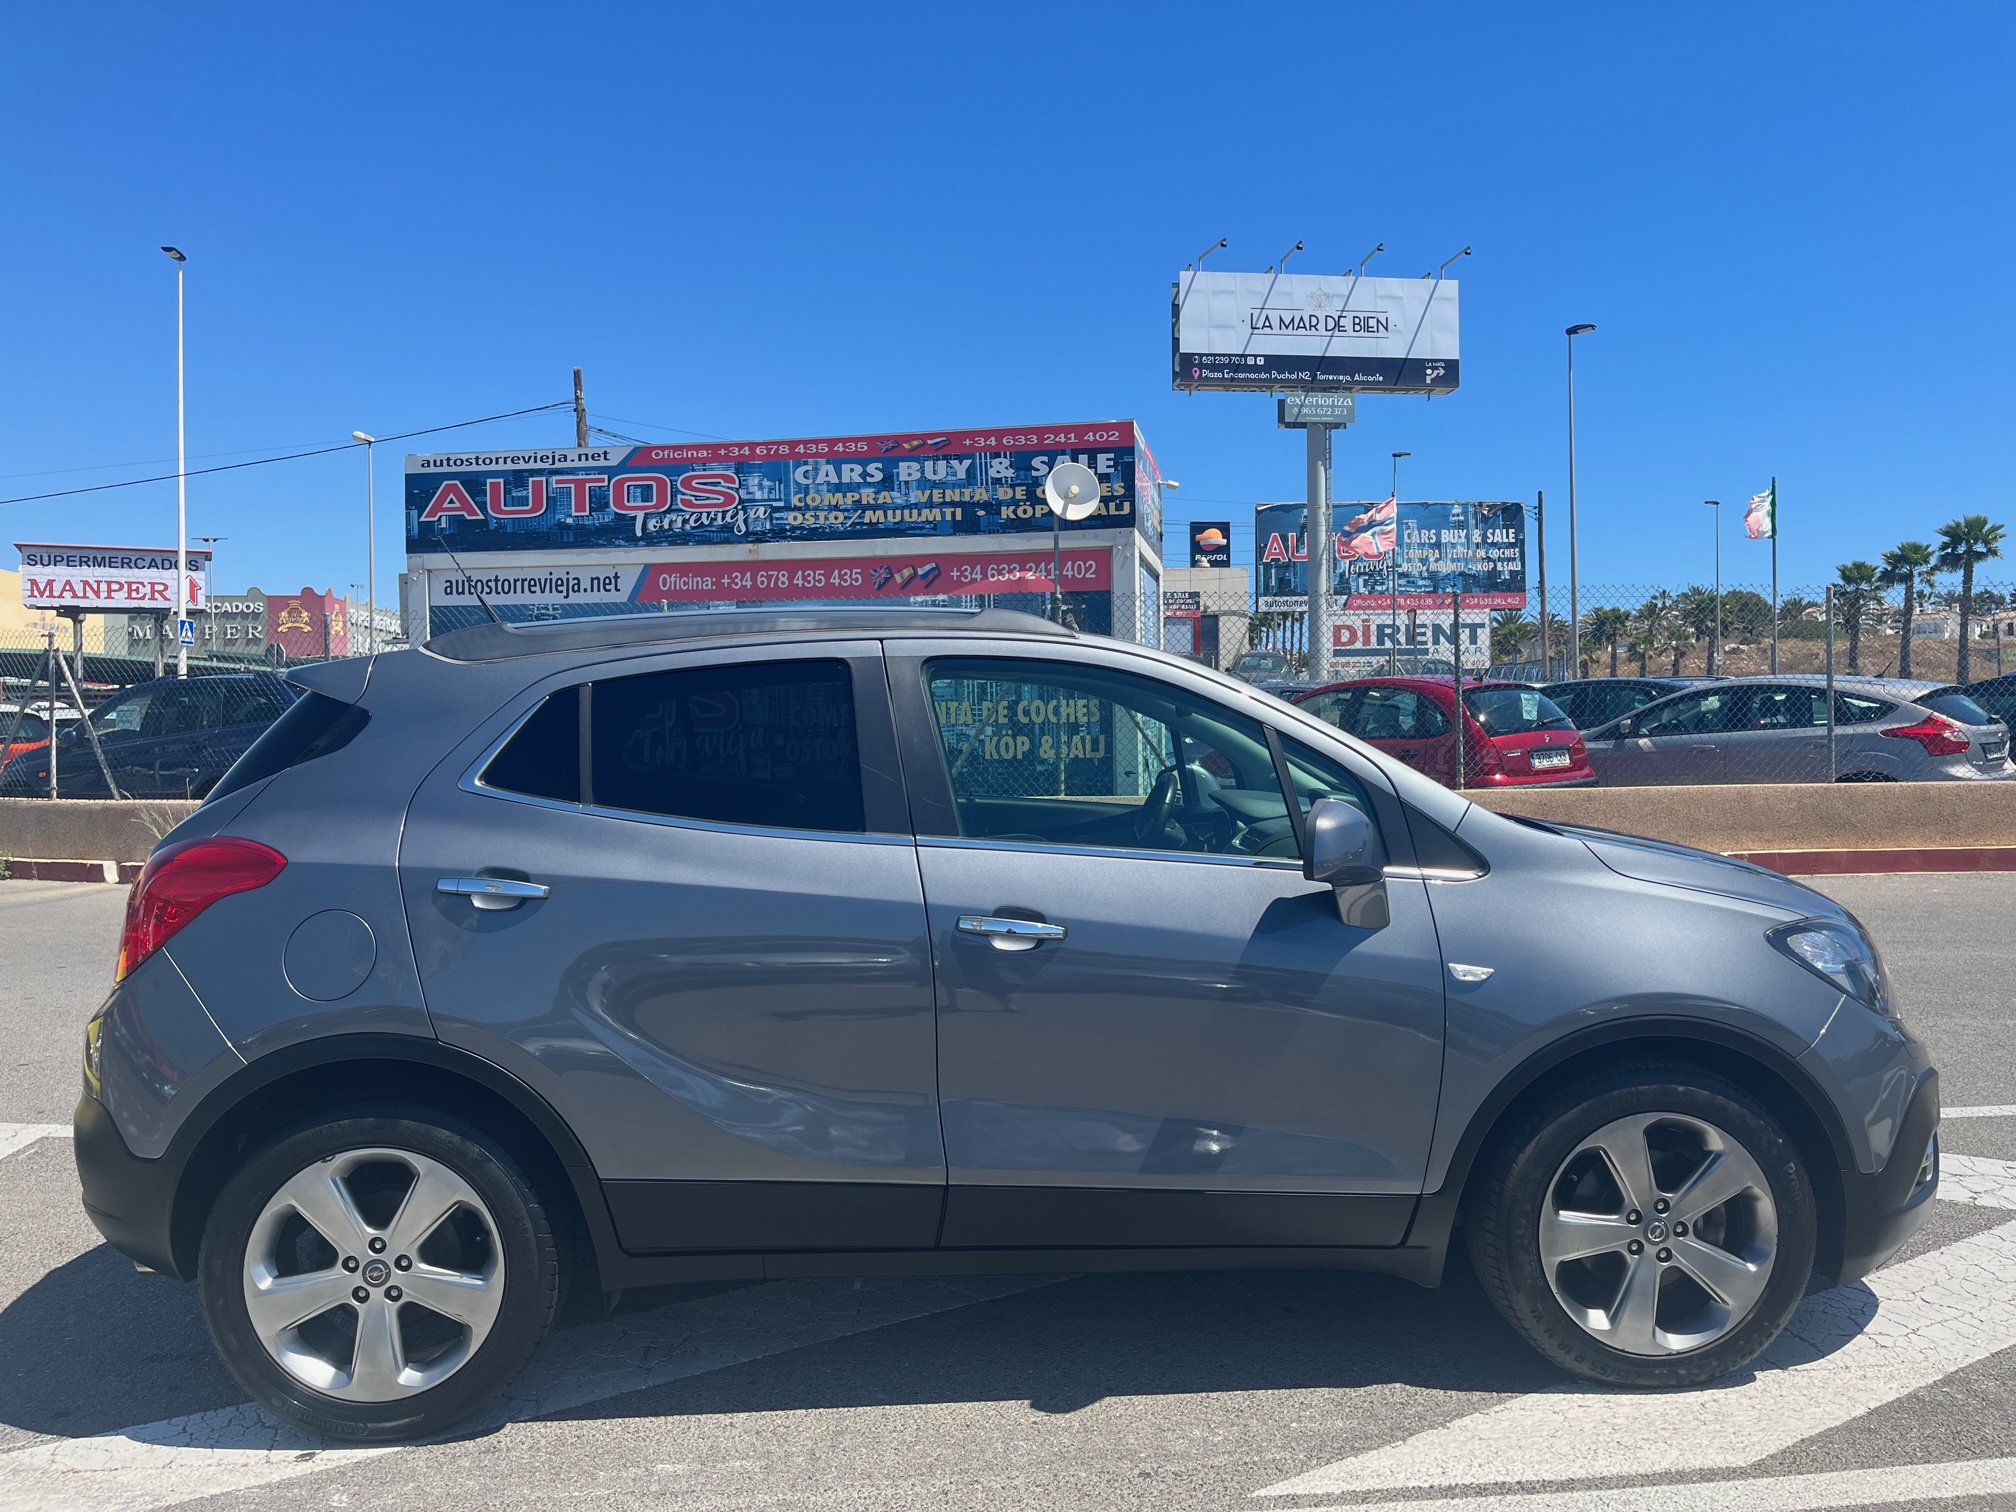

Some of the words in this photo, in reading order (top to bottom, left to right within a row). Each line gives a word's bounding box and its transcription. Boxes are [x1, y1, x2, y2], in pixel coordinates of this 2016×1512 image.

[1250, 313, 1273, 330] LA
[1279, 314, 1320, 331] MAR
[1324, 314, 1347, 333] DE
[1352, 316, 1389, 333] BIEN
[1202, 369, 1222, 378] Plaza
[1271, 370, 1297, 380] Puchol
[1354, 373, 1384, 382] Alicante
[1287, 395, 1352, 406] exterioriza
[962, 436, 997, 447] +34
[1002, 434, 1038, 445] 633
[1043, 433, 1079, 444] 241
[1084, 431, 1120, 442] 402
[421, 450, 611, 468] autostorrevieja.net
[651, 449, 713, 459] Oficina:
[717, 446, 751, 457] +34
[756, 445, 789, 455] 678
[795, 443, 828, 454] 435
[833, 441, 868, 452] 435
[794, 462, 884, 485] CARS
[898, 459, 973, 482] BUY
[988, 457, 1017, 478] &
[419, 471, 740, 522] AUTOS
[793, 491, 893, 507] COMPRA
[916, 488, 990, 503] VENTA
[998, 486, 1027, 500] DE
[1036, 482, 1125, 499] CES
[628, 504, 771, 537] Torrevieja
[1001, 502, 1050, 519] KÖP
[1404, 529, 1436, 543] CARS
[1441, 529, 1467, 543] BUY
[1473, 529, 1482, 543] &
[1487, 528, 1515, 543] SALE
[1404, 549, 1439, 559] COMPRA
[1447, 549, 1473, 558] VENTA
[1476, 549, 1486, 558] DE
[1489, 548, 1519, 558] COCHES
[950, 564, 982, 583] +34
[987, 563, 1020, 582] 633
[1025, 562, 1057, 580] 241
[1062, 560, 1097, 579] 402
[1476, 560, 1494, 571] KÖP
[444, 572, 621, 599] autostorrevieja.net
[659, 573, 717, 591] Oficina:
[721, 572, 752, 590] +34
[757, 570, 789, 588] 678
[793, 569, 825, 588] 435
[829, 568, 863, 586] 435
[27, 579, 171, 601] MANPER
[132, 624, 263, 640] MAPER
[982, 701, 1008, 723] DE
[1017, 699, 1100, 723] COCHES
[985, 730, 1030, 760] KÖP
